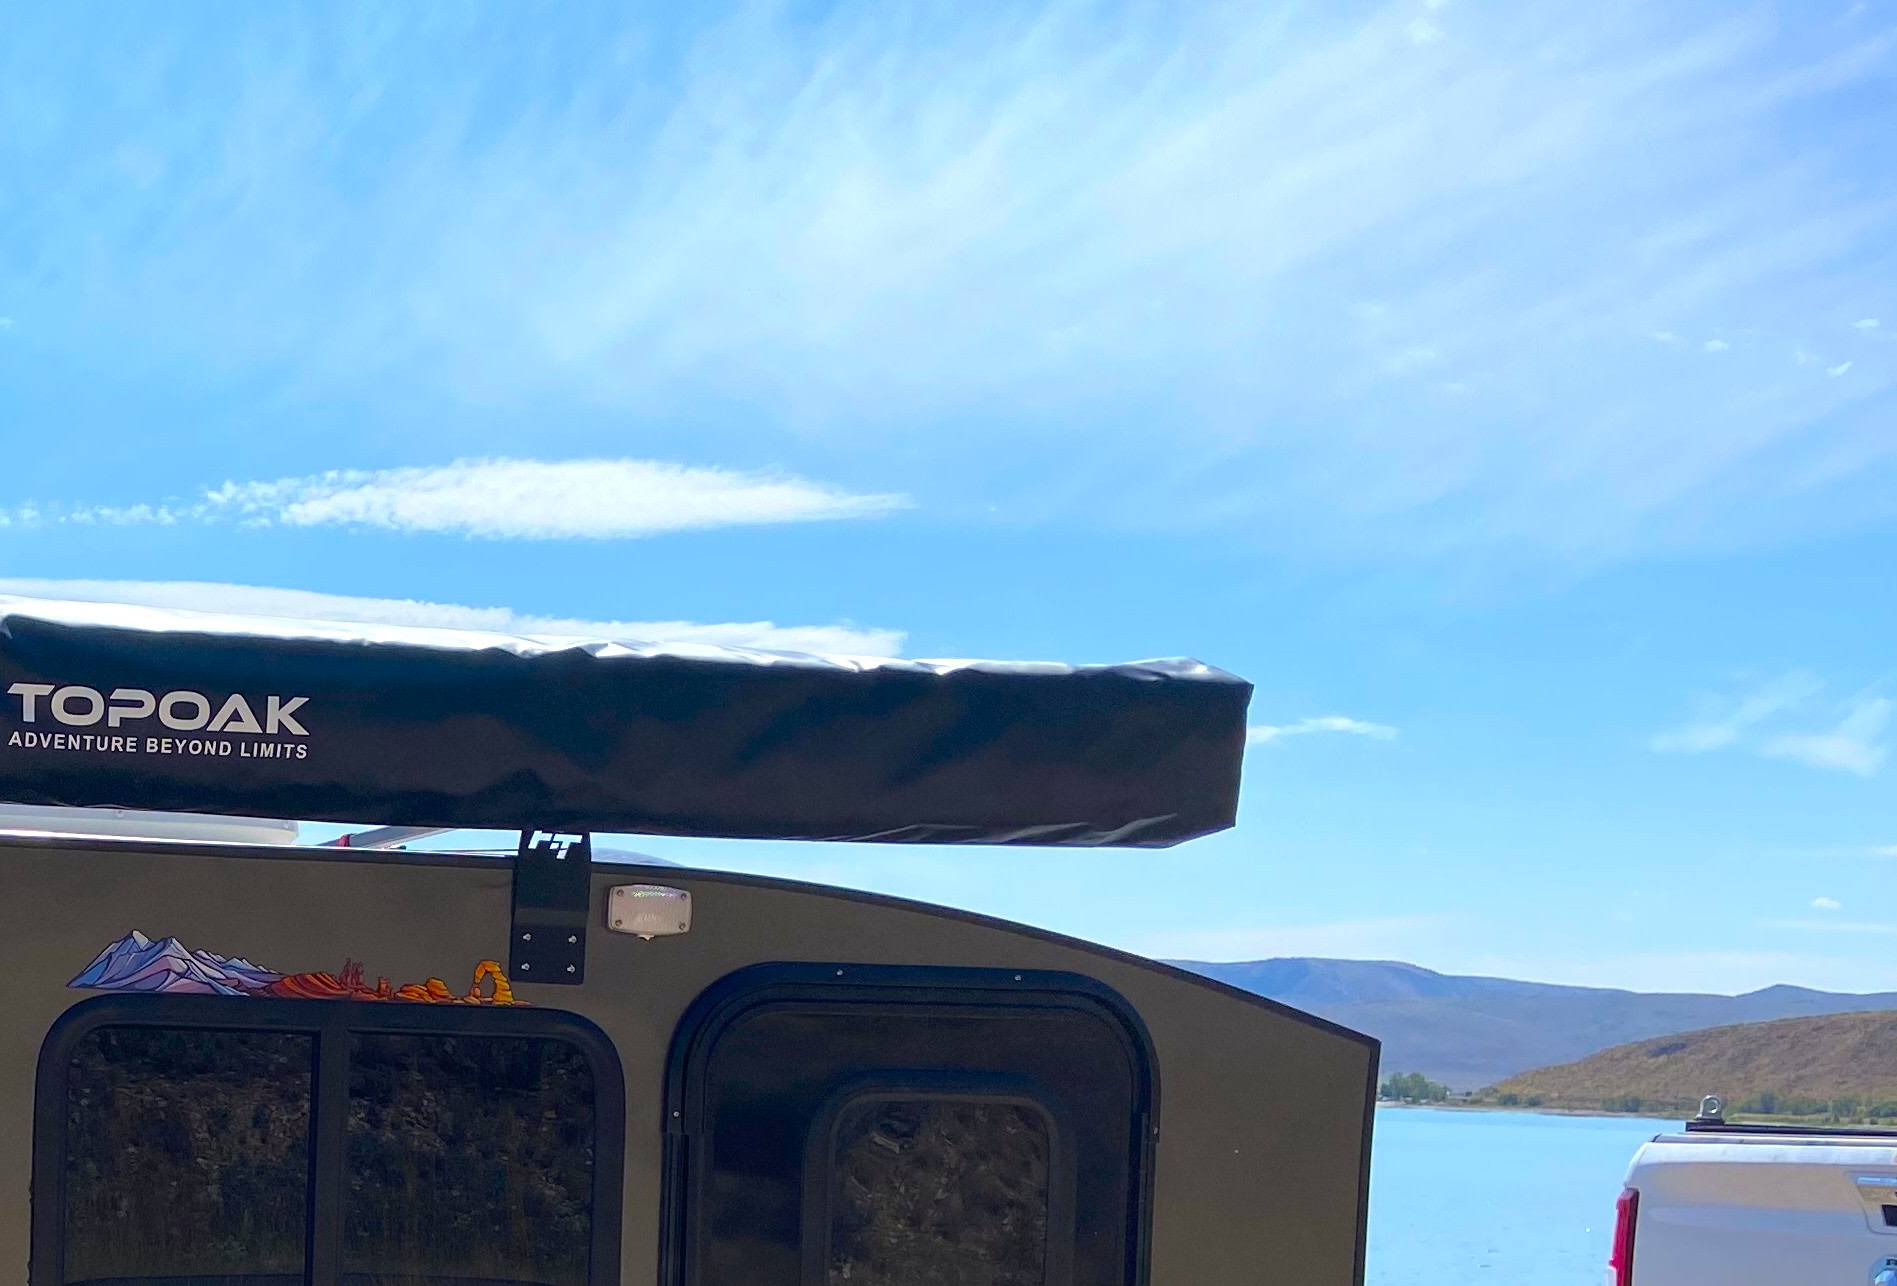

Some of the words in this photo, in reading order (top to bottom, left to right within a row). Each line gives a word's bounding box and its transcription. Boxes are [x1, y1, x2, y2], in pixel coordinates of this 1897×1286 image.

[6, 681, 311, 737] TOPOAK
[7, 730, 138, 753] ADVENTURE
[145, 737, 233, 757] BEYOND
[239, 741, 309, 760] LIMITS
